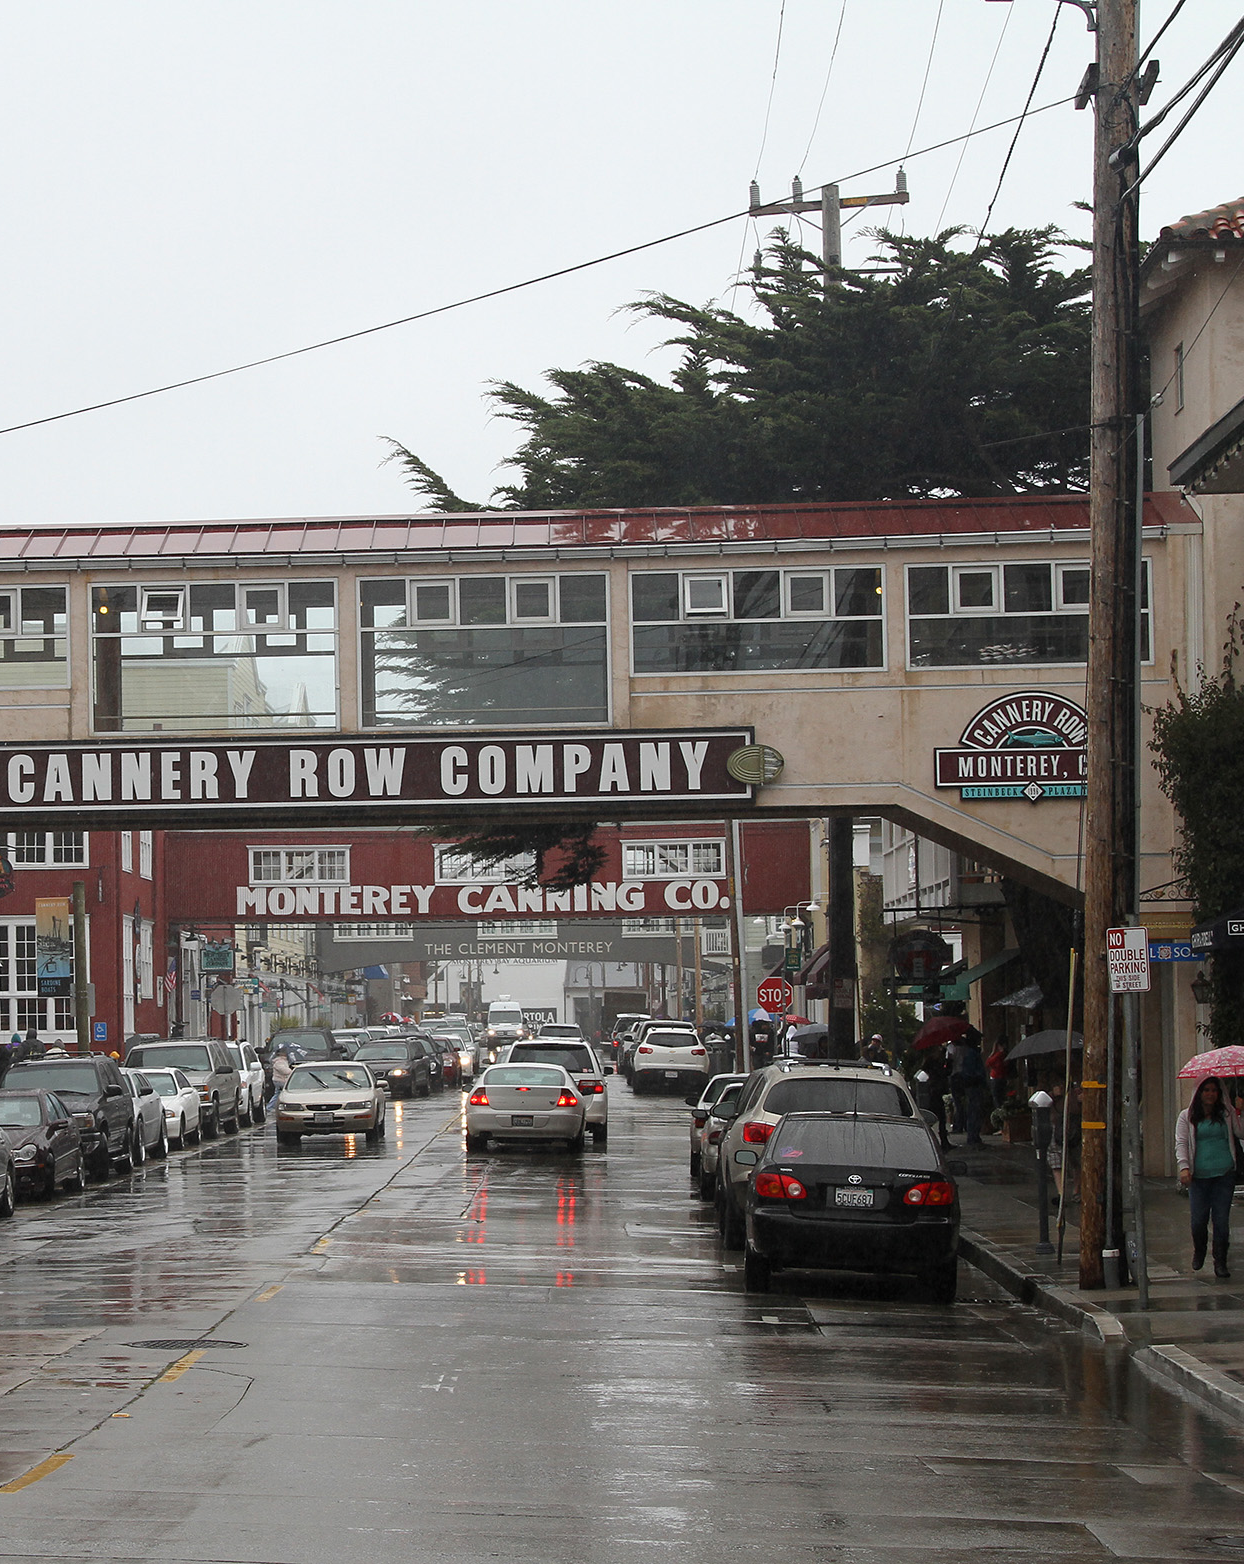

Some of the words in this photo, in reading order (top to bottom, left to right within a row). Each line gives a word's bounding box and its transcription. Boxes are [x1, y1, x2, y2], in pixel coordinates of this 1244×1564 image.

[973, 700, 1055, 746] CANNERY
[1052, 707, 1087, 744] ROW
[7, 750, 256, 803] CANNERY
[289, 748, 406, 798] ROW
[440, 741, 709, 795] COMPANY
[958, 754, 1069, 779] MONTEREY,
[964, 787, 1019, 797] STEINBECK
[1048, 786, 1078, 795] PLAZA
[236, 885, 436, 916] MONTEREY
[456, 881, 645, 914] CANNING
[664, 880, 730, 910] CO.
[1109, 932, 1122, 946] NO
[424, 943, 452, 955] THE
[458, 943, 526, 955] CLEMENT
[532, 941, 613, 954] MONTEREY
[1109, 948, 1145, 962] DOUBLE
[1110, 961, 1147, 974] PARKING
[1122, 981, 1142, 989] STREET
[759, 989, 790, 1003] STOP
[523, 1011, 555, 1024] RTOLA
